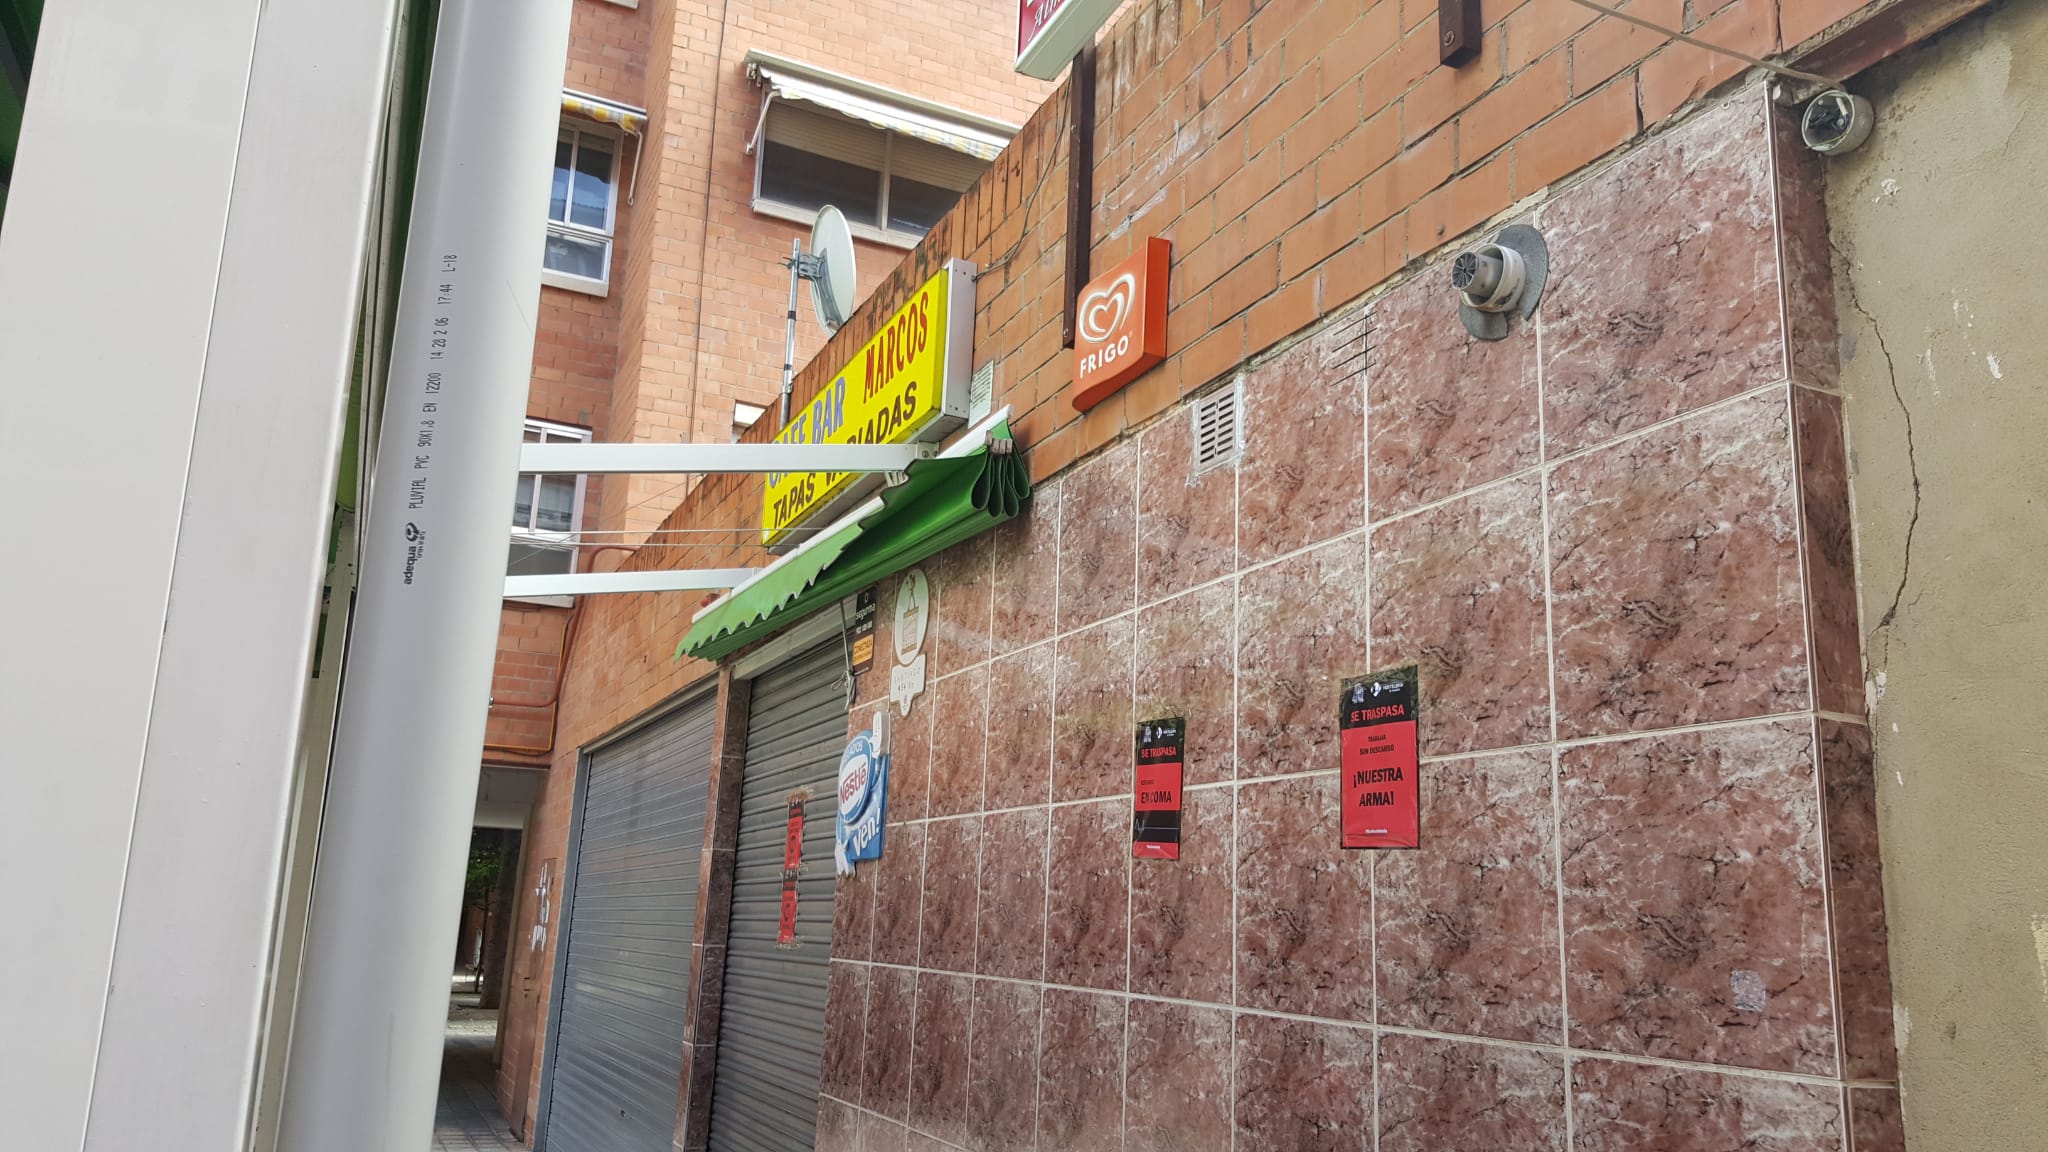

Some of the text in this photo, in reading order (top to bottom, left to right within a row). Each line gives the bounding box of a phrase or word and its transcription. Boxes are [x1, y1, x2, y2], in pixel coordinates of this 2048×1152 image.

[442, 254, 458, 273] L-18
[437, 284, 453, 305] 17:44
[430, 351, 444, 360] 14
[1079, 335, 1129, 379] FRIGO
[811, 376, 846, 446] BAR
[863, 291, 929, 404] MARCOS
[425, 372, 442, 394] 12200
[422, 402, 438, 413] EN
[414, 455, 430, 469] PVC
[773, 472, 816, 529] TAPAS
[826, 381, 917, 486] IADAS
[408, 477, 427, 509] PLUVIAL
[403, 545, 418, 585] adequa
[1351, 704, 1405, 722] SE TRASPASA
[1141, 748, 1149, 758] SE
[1353, 767, 1404, 788] ¡NUESTRA
[1359, 791, 1395, 807] ARMA!
